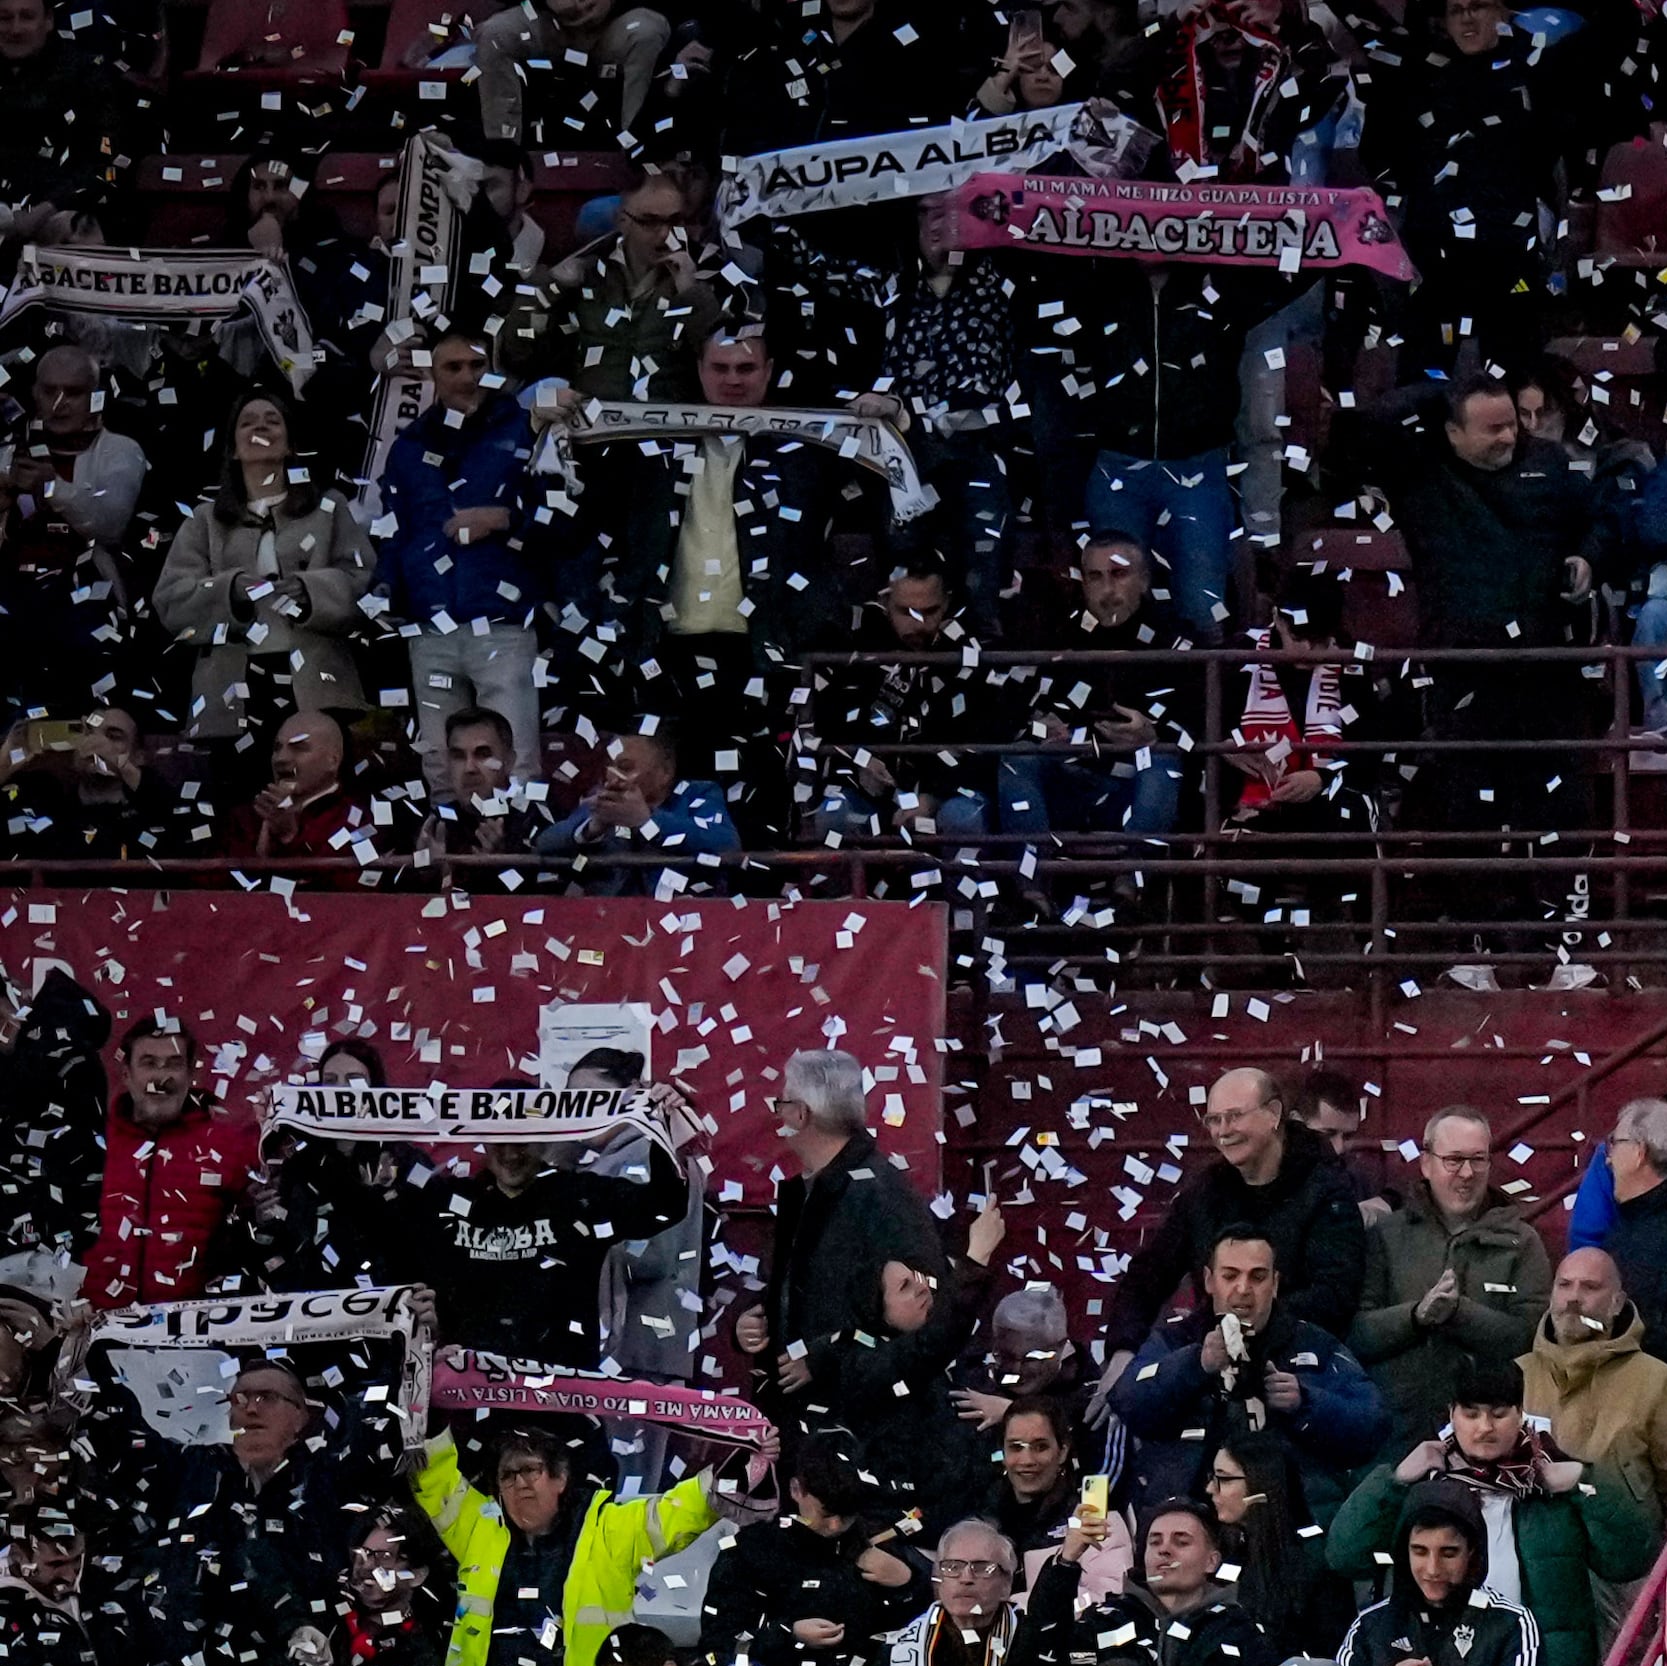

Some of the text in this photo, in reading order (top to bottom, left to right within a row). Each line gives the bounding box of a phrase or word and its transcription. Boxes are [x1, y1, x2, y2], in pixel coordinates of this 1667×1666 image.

[766, 123, 1055, 192] AÚPA ALBA
[1023, 179, 1044, 192] MI
[1115, 183, 1145, 198] ME
[1199, 188, 1261, 204] GUAPA
[1266, 189, 1320, 206] LISTA
[1028, 206, 1341, 258] ALBACETEÑA
[296, 1090, 460, 1121] ALBACEE
[470, 1386, 528, 1401] LISTA
[655, 1400, 683, 1416] ME
